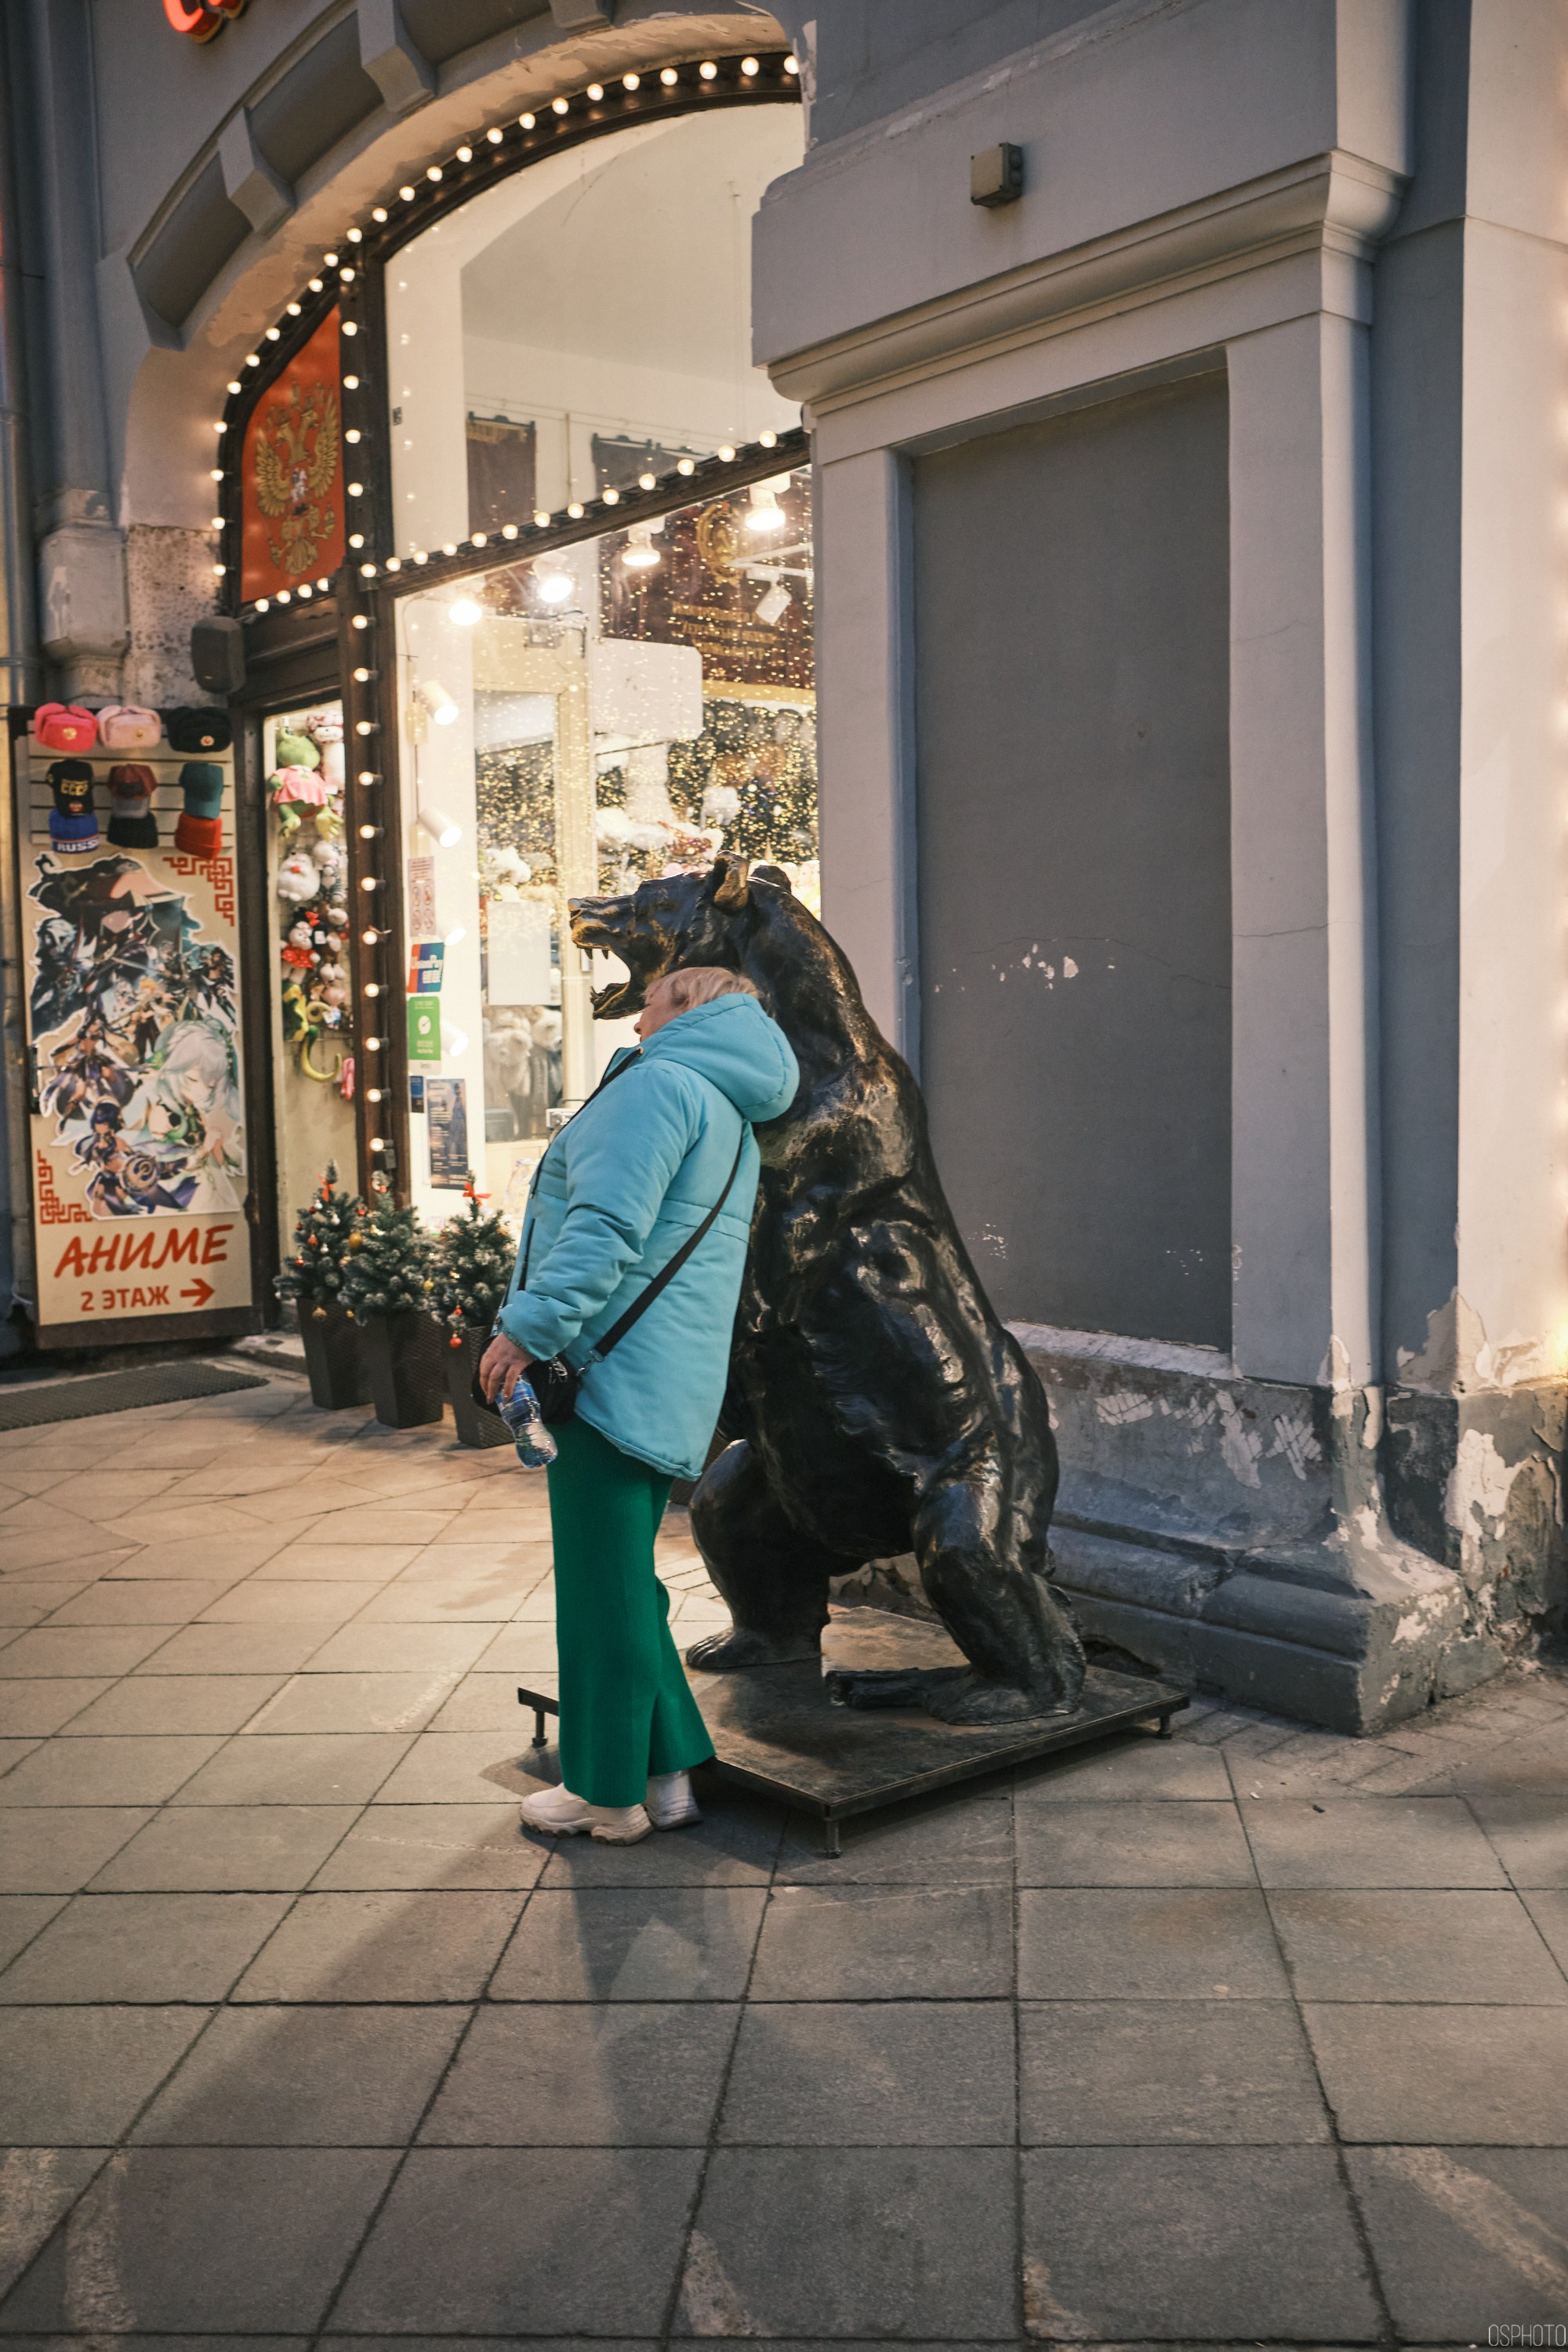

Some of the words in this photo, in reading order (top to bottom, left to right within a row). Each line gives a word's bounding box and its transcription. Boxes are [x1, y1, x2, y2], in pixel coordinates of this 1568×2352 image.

[53, 1224, 234, 1279] АНИМЕ
[81, 1290, 95, 1312] 2
[102, 1284, 170, 1310] ЭТАЖ
